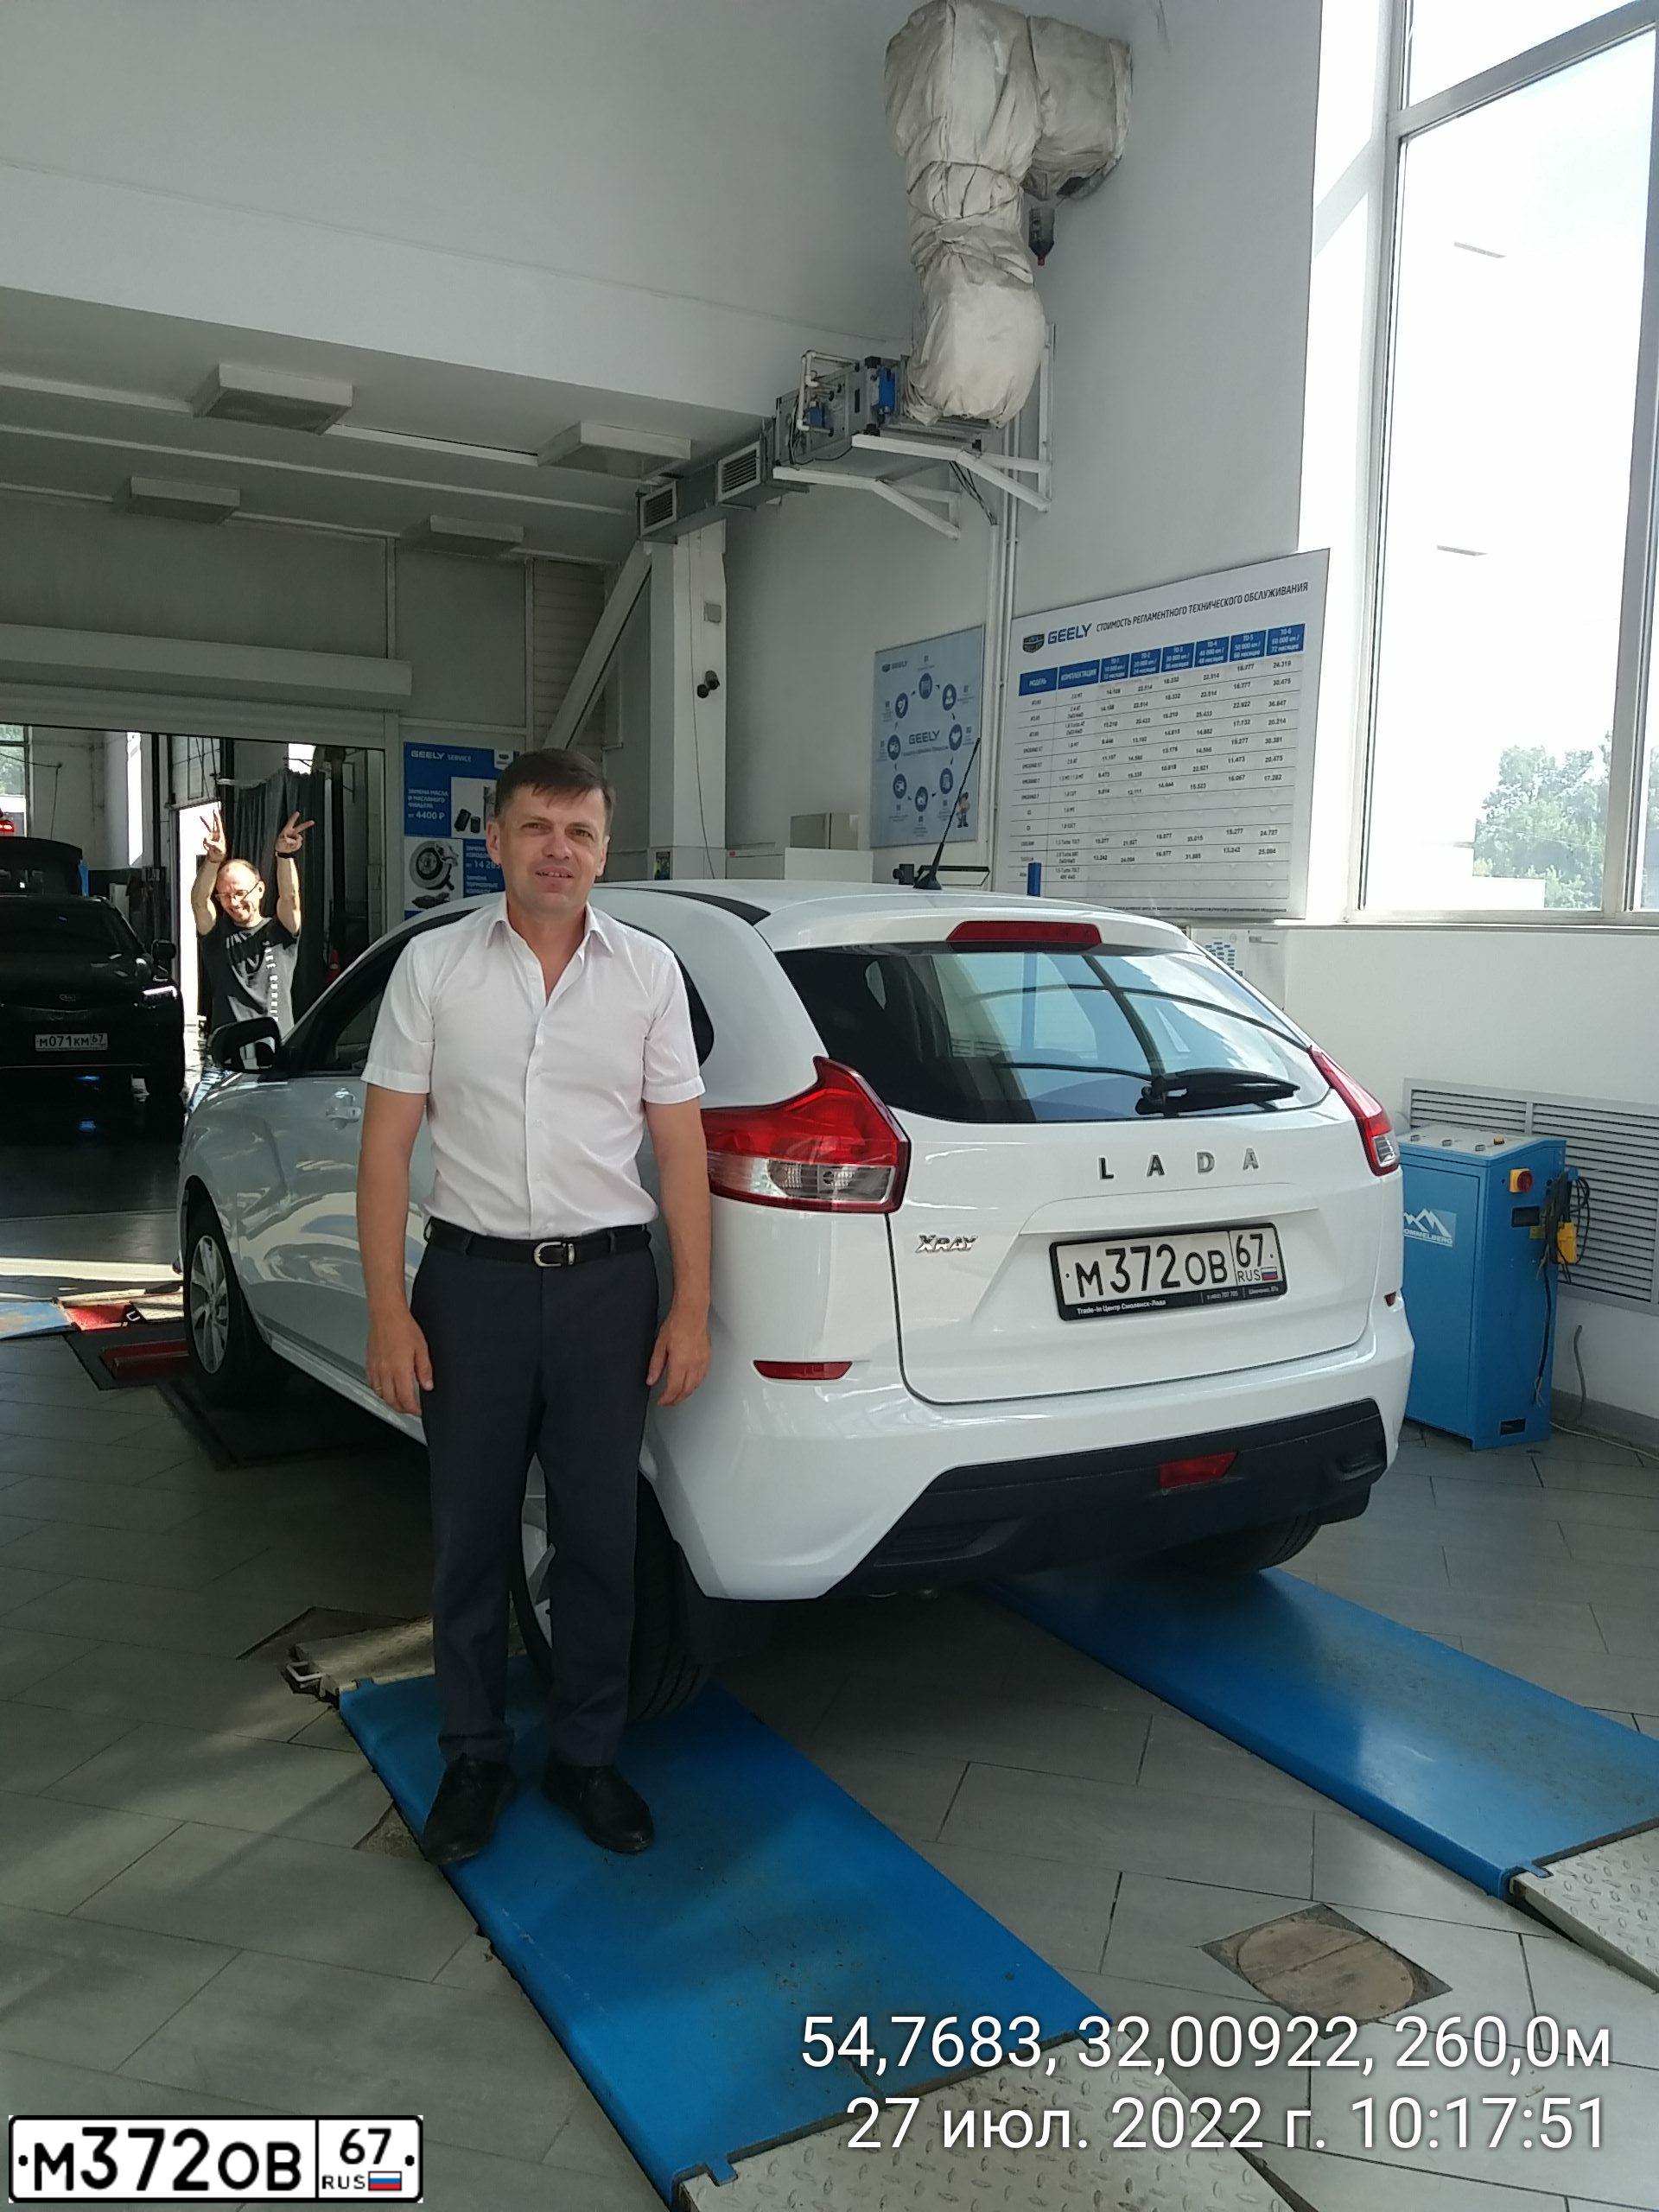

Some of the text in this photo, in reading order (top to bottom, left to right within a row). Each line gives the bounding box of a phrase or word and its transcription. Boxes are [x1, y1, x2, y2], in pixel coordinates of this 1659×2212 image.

[1096, 582, 1308, 632] СТОИМОСТЬ РЕГЛАМЕНТНОГО ТЕХНИЧЕСКОГО ОБСЛУЖИВАНИЯ
[1048, 623, 1092, 645] GEELY
[909, 730, 940, 745] GEELY
[410, 750, 472, 762] GEELY SERVICE
[416, 810, 437, 820] 4400
[39, 1034, 104, 1046] М071КМ 67
[1098, 1147, 1259, 1180] LADA
[915, 1235, 978, 1253] XRAY
[1075, 1233, 1263, 1298] М372ОВ 67
[1237, 1269, 1262, 1283] RUS
[1077, 1306, 1103, 1315] Trade-In
[1103, 1303, 1121, 1313] Центр
